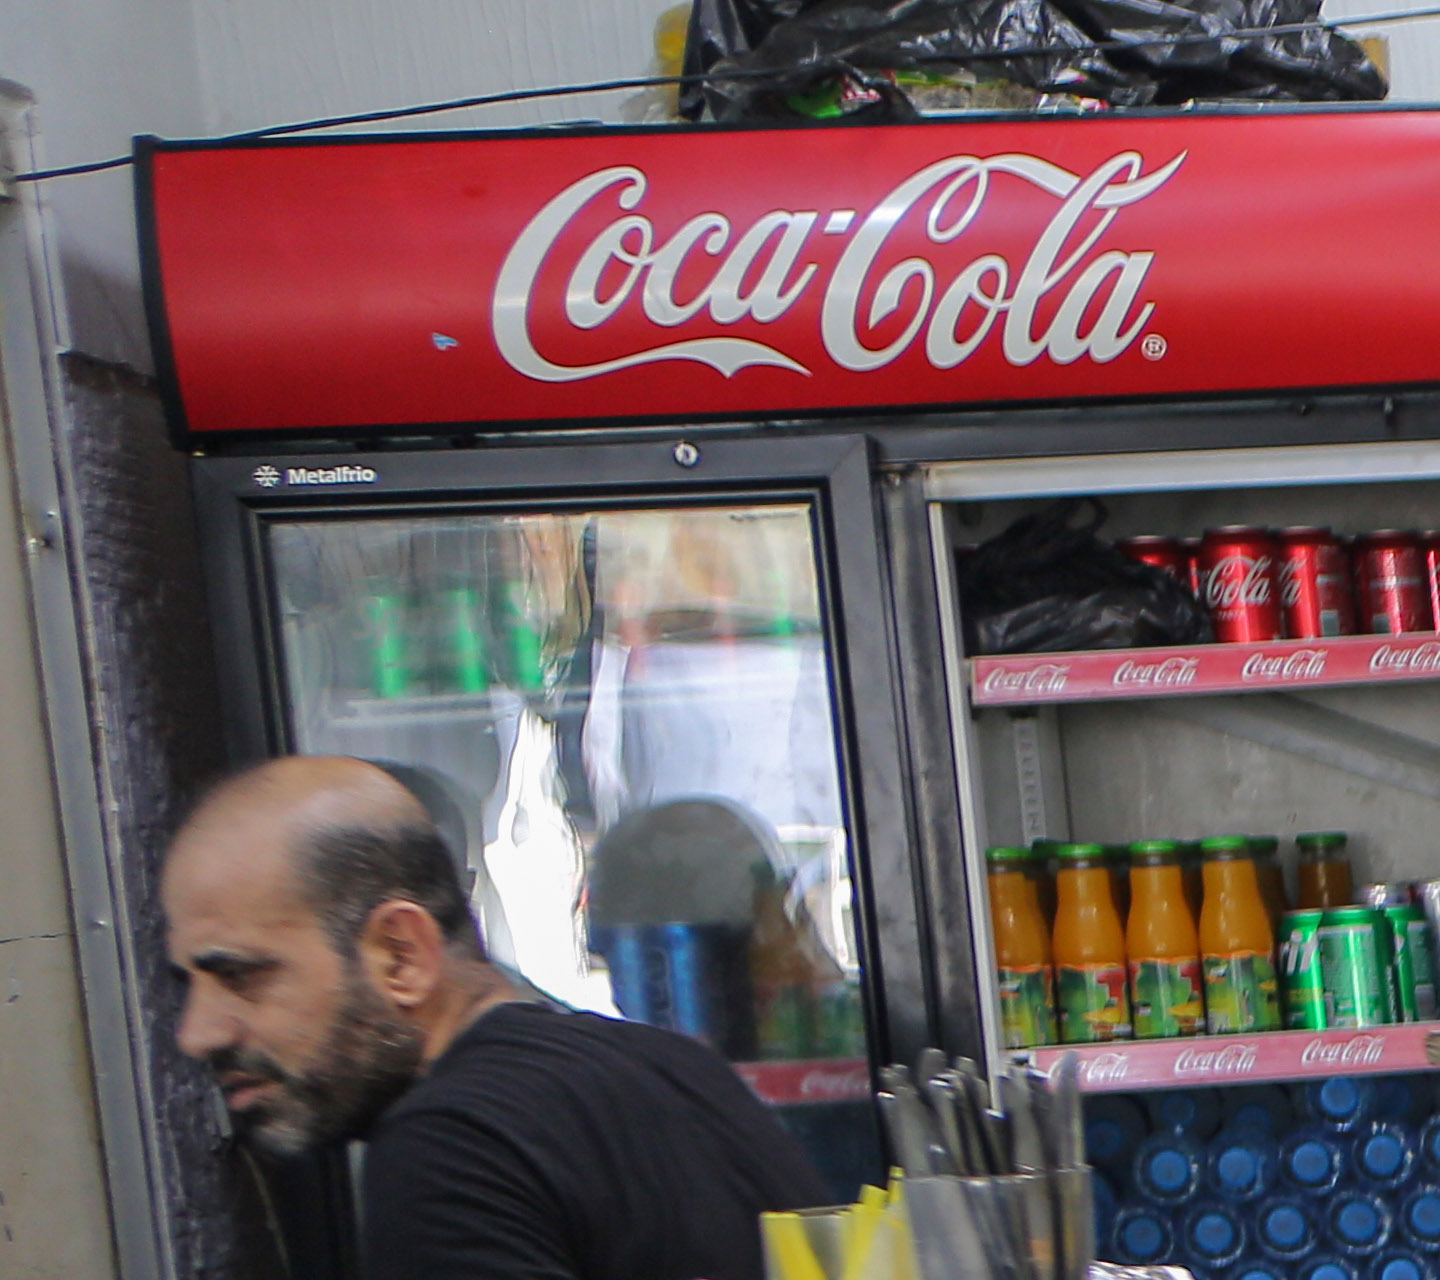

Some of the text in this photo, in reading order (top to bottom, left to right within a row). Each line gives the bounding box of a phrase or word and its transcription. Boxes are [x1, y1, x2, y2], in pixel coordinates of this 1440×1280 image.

[492, 148, 1188, 382] Coca-Cola
[288, 466, 376, 485] Metalfrio
[1112, 656, 1200, 688] Coca-Cola
[1240, 649, 1328, 681] Coca-Cola
[1174, 1044, 1260, 1077] Coca-Cola
[1301, 1034, 1387, 1066] Coca-Cola
